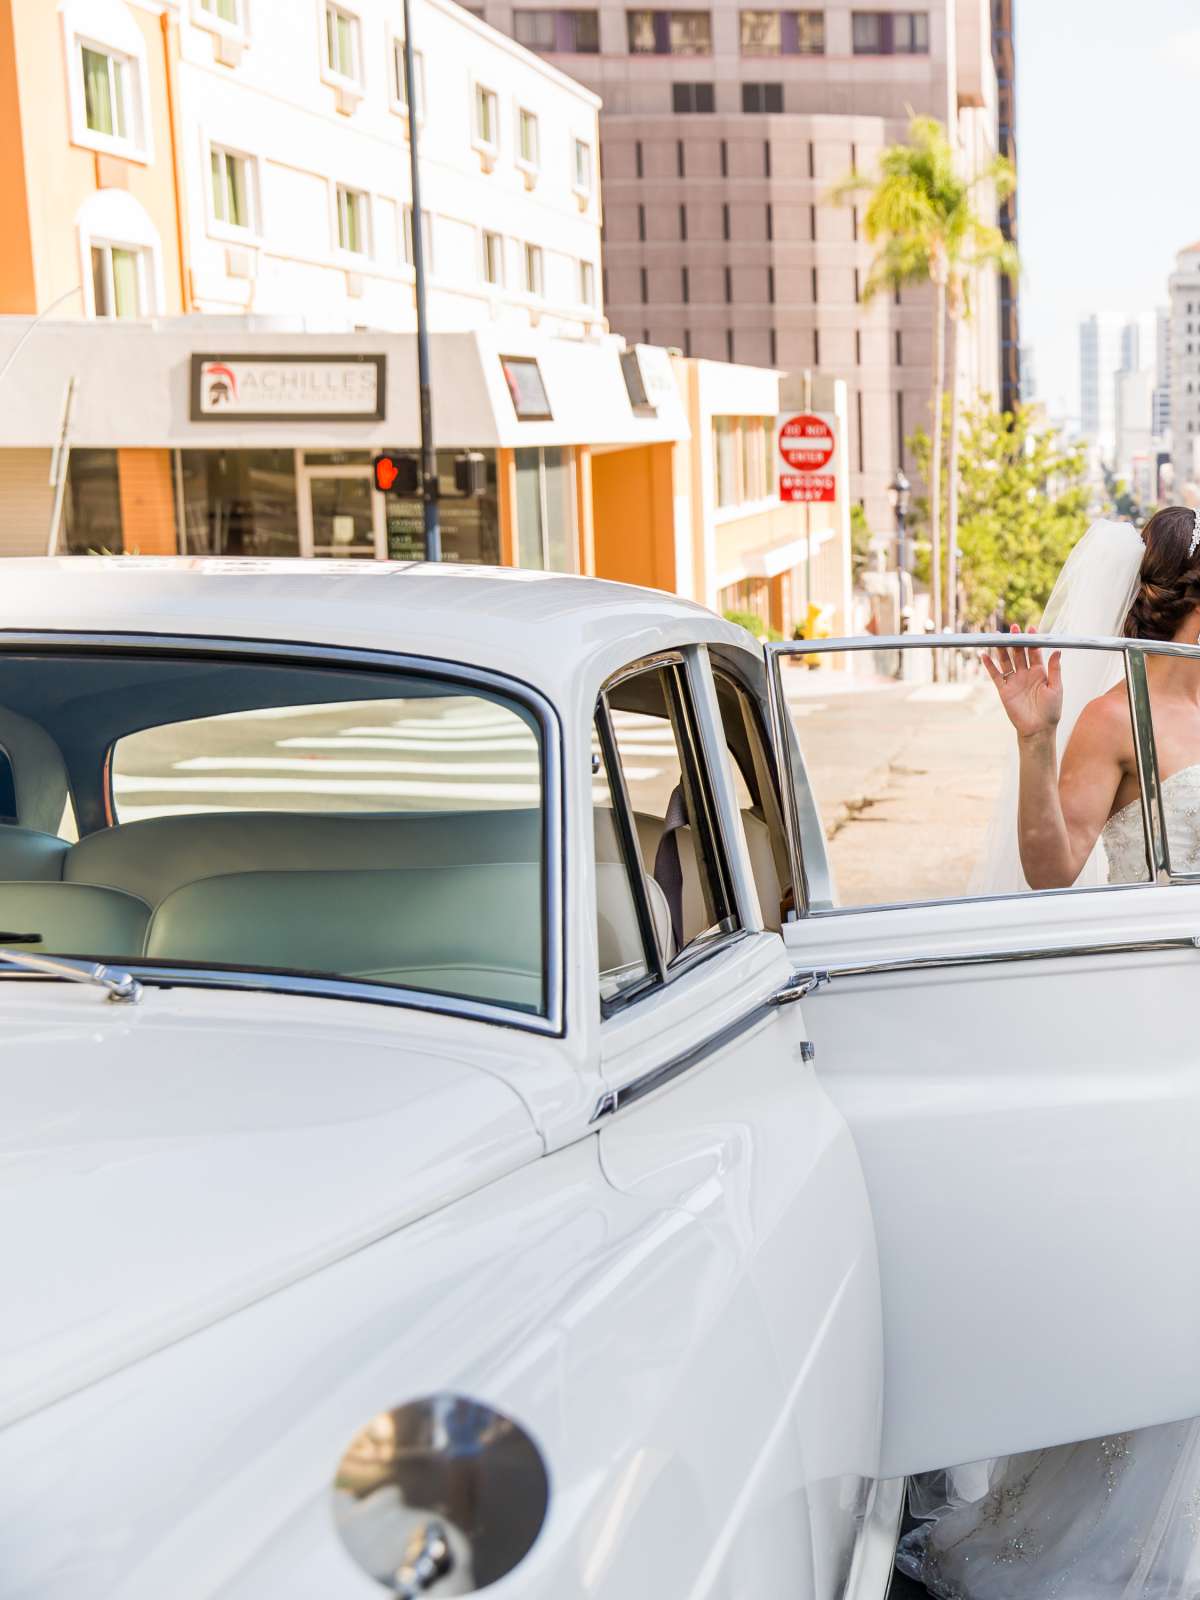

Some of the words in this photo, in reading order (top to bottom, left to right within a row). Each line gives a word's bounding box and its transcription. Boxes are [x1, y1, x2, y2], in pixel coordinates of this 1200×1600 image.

[241, 370, 374, 392] ACHILLES
[805, 424, 827, 436] NOT
[787, 450, 824, 463] ENTER
[782, 477, 834, 490] WRONG
[792, 489, 823, 501] WAY
